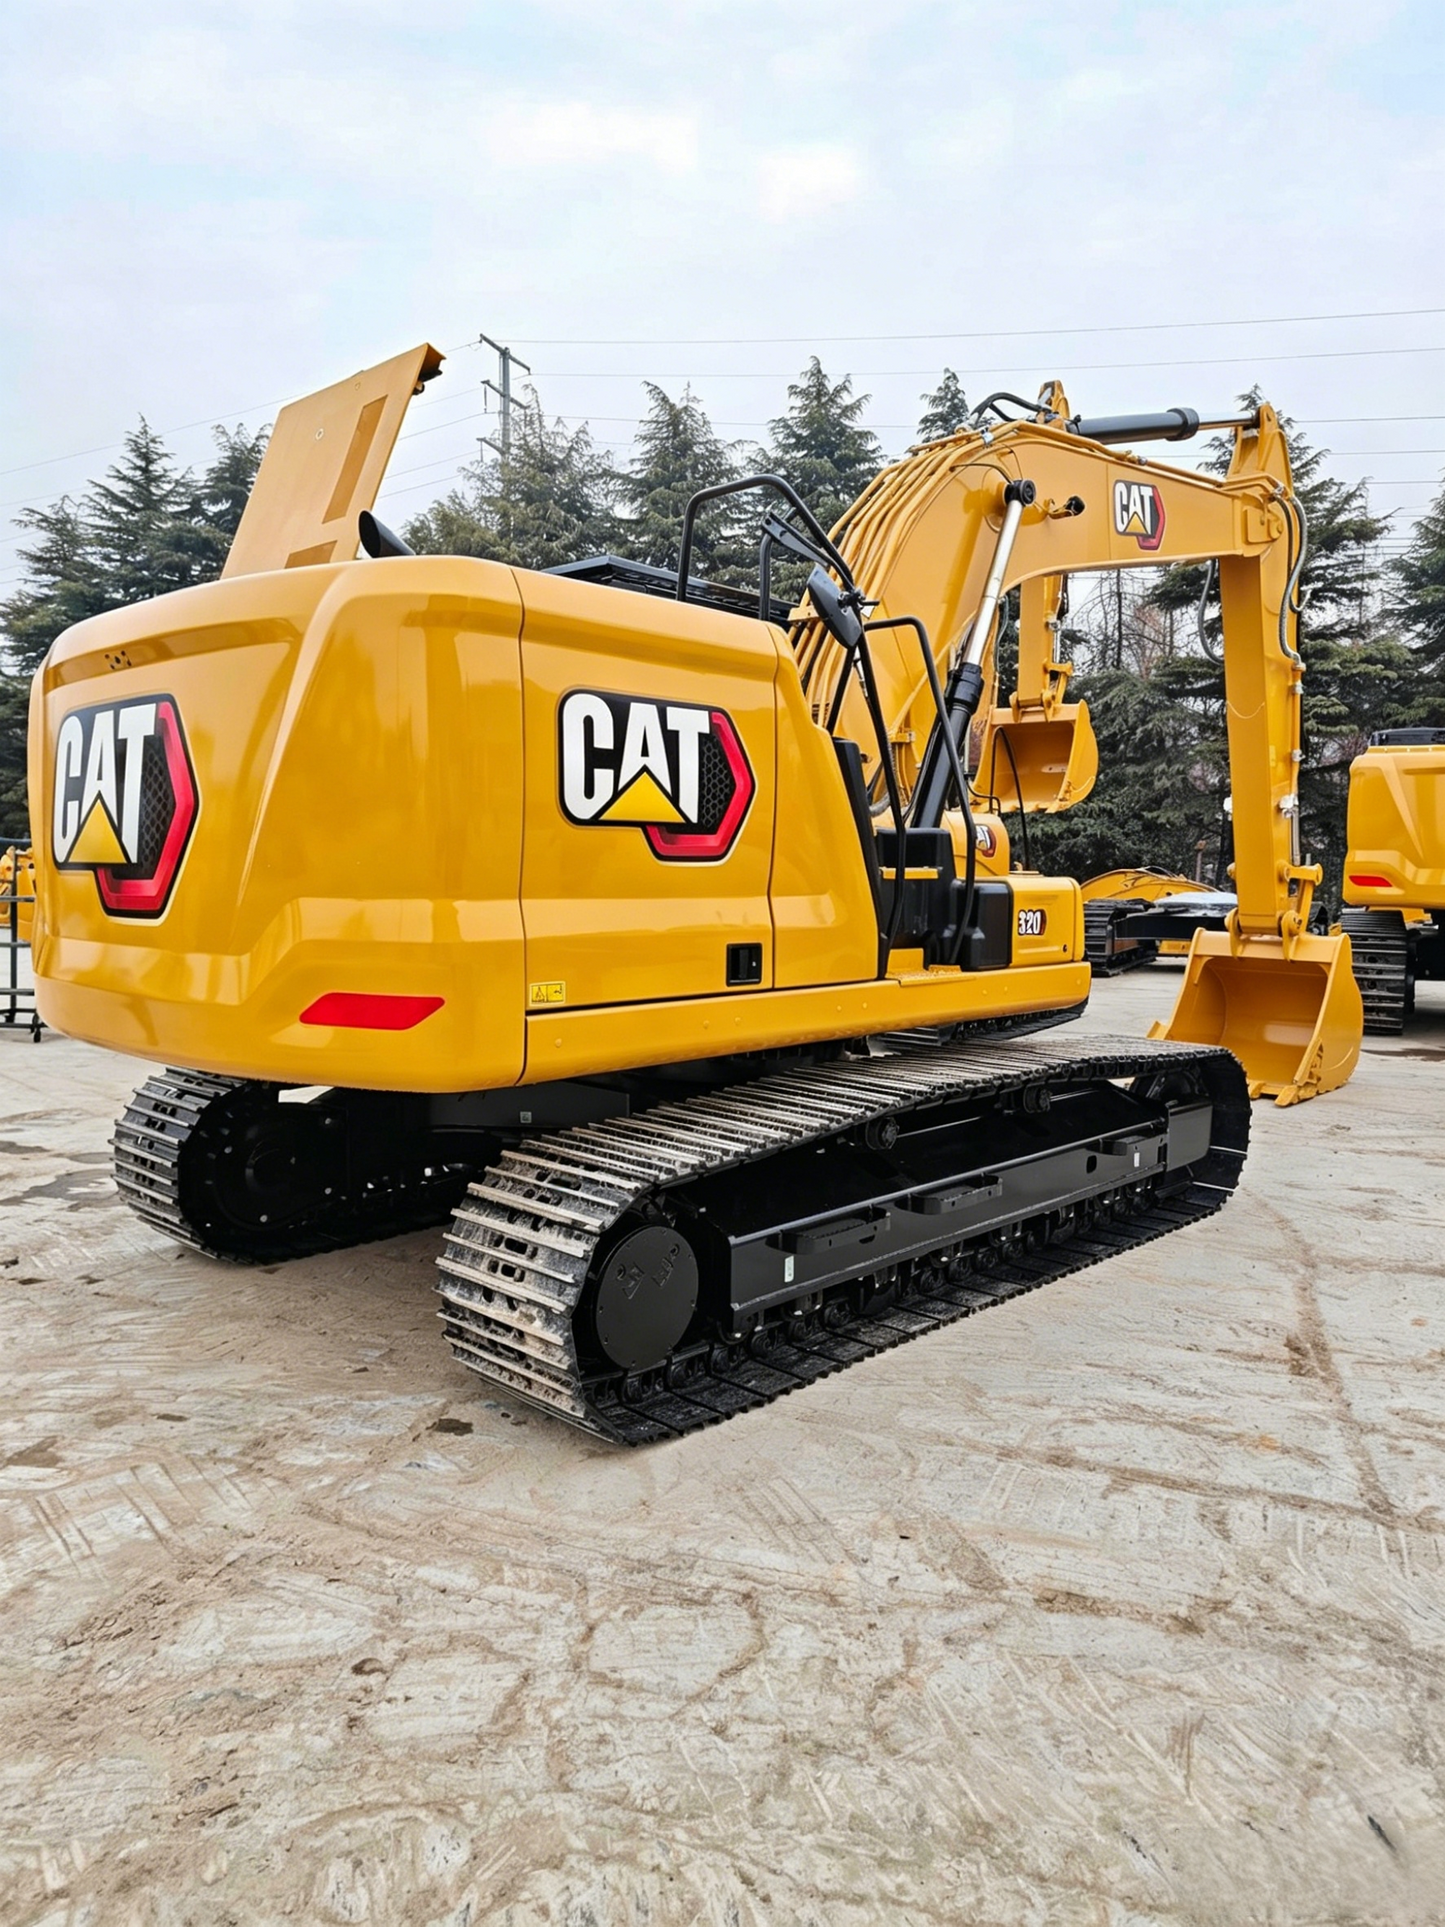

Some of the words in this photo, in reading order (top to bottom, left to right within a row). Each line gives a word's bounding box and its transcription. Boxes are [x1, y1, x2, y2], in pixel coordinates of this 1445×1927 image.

[1115, 482, 1153, 535] CAT
[54, 703, 157, 863] CAT
[563, 693, 710, 824] CAT
[975, 825, 990, 849] AT
[1018, 910, 1041, 935] 320
